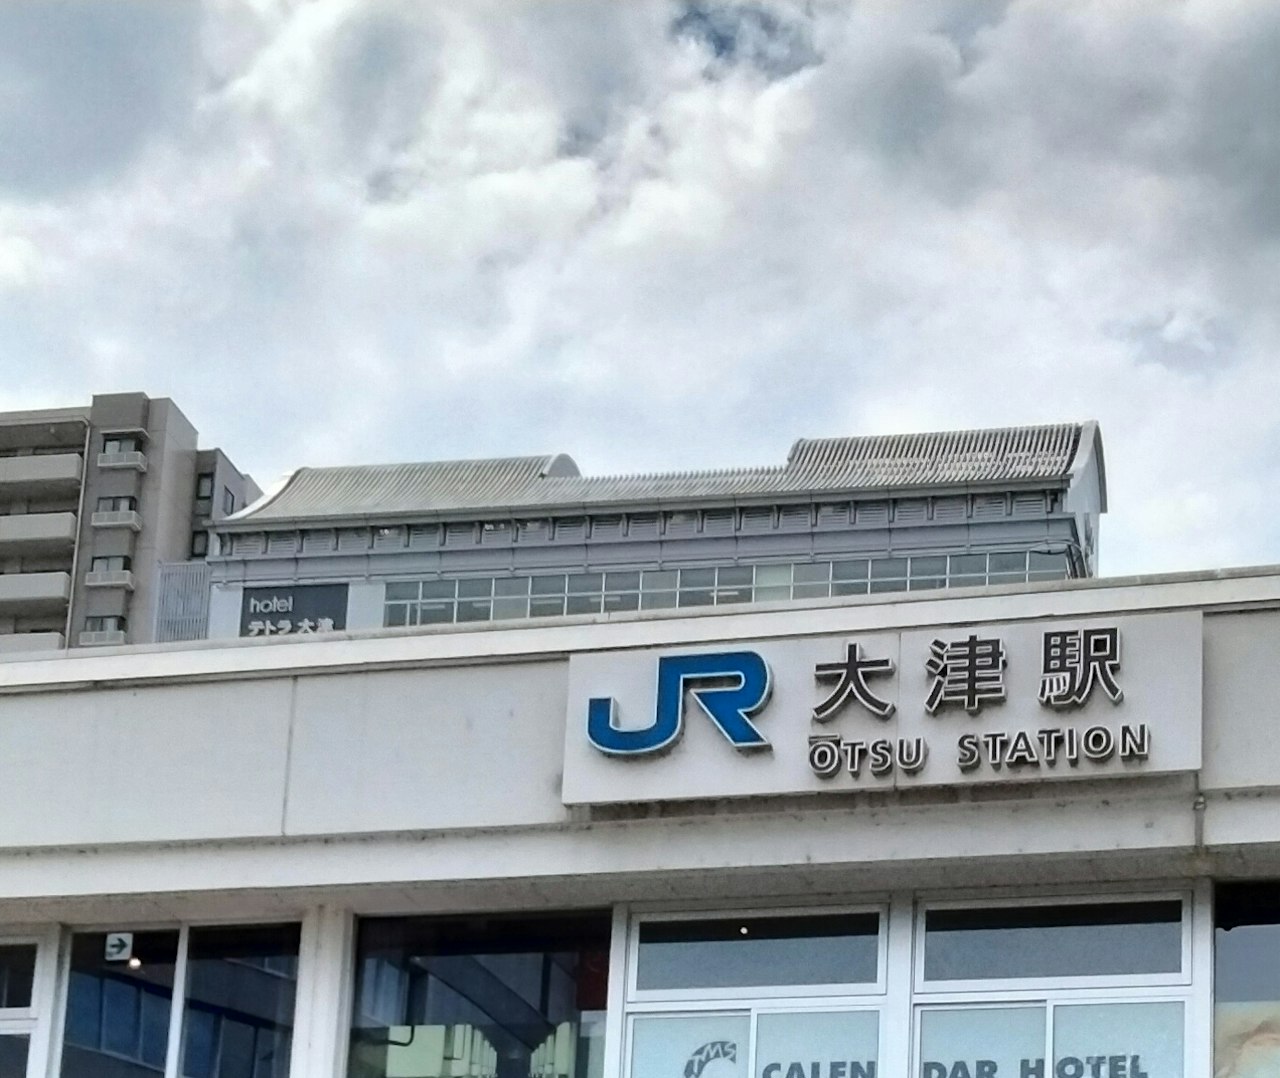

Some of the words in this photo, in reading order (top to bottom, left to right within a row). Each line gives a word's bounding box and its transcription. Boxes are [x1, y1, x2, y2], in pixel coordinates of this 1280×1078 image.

[250, 595, 293, 613] hotel
[587, 650, 773, 755] JR
[813, 627, 1124, 719] 大津駅
[957, 723, 1150, 770] STATION
